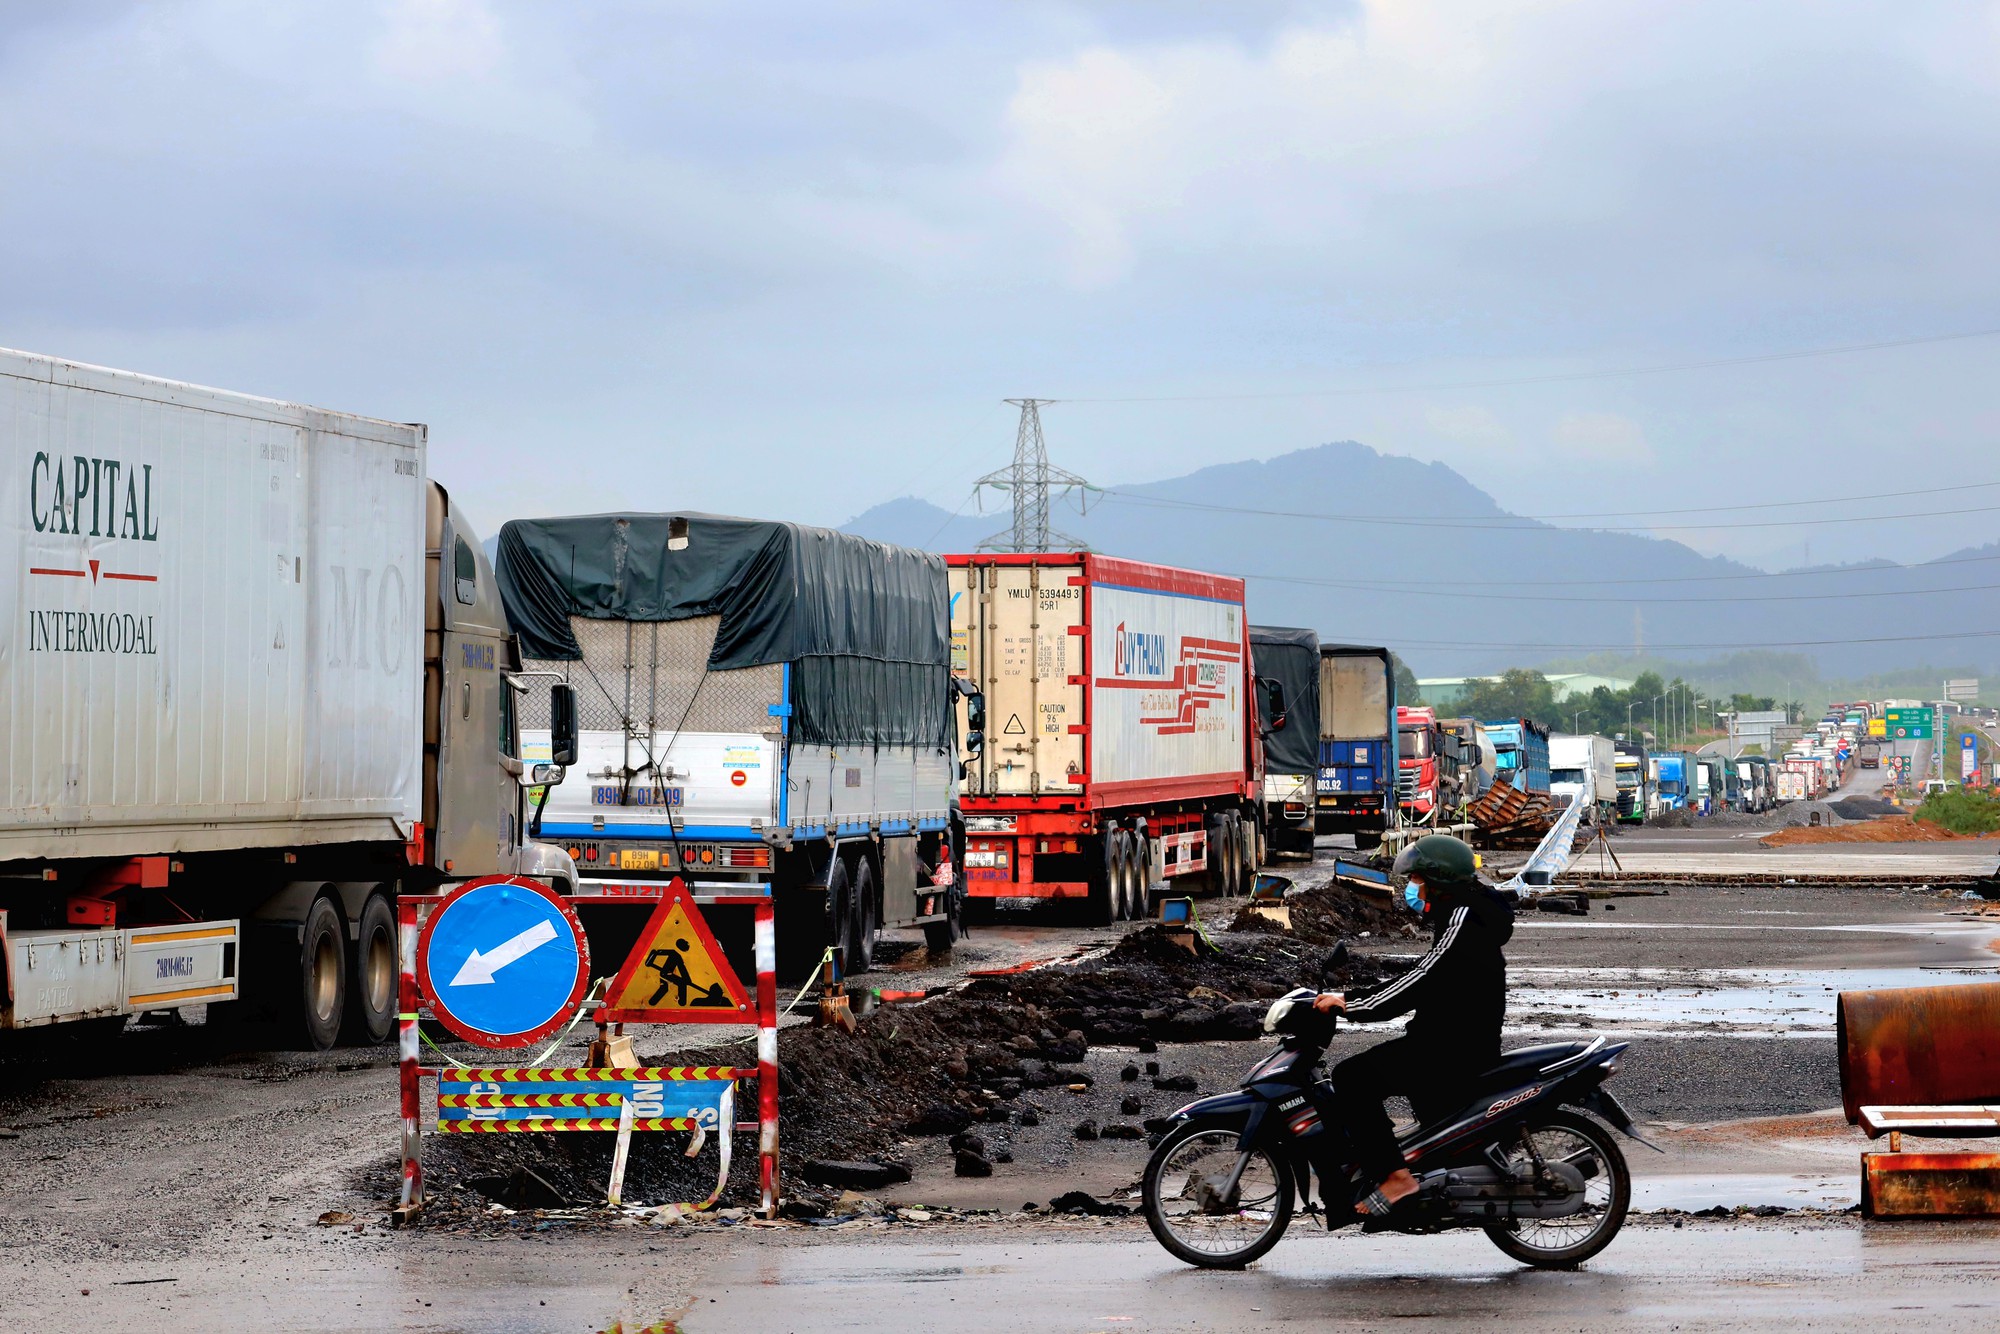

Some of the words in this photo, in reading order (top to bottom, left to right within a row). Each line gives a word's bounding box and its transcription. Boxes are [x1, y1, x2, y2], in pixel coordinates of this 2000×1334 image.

[30, 451, 159, 542] CAPITAL
[1007, 588, 1030, 599] YMLU
[1039, 588, 1072, 599] 539449
[1073, 588, 1080, 599] 3
[1039, 600, 1059, 611] 45R1
[29, 610, 158, 656] INTERMODAL
[1039, 703, 1066, 713] CAUTION
[1045, 723, 1060, 733] HIGH
[1316, 779, 1341, 791] 003.92
[632, 851, 649, 860] 89H
[624, 860, 655, 869] 012.09
[37, 985, 74, 1011] PATEC
[1277, 1095, 1306, 1113] YAMAHA
